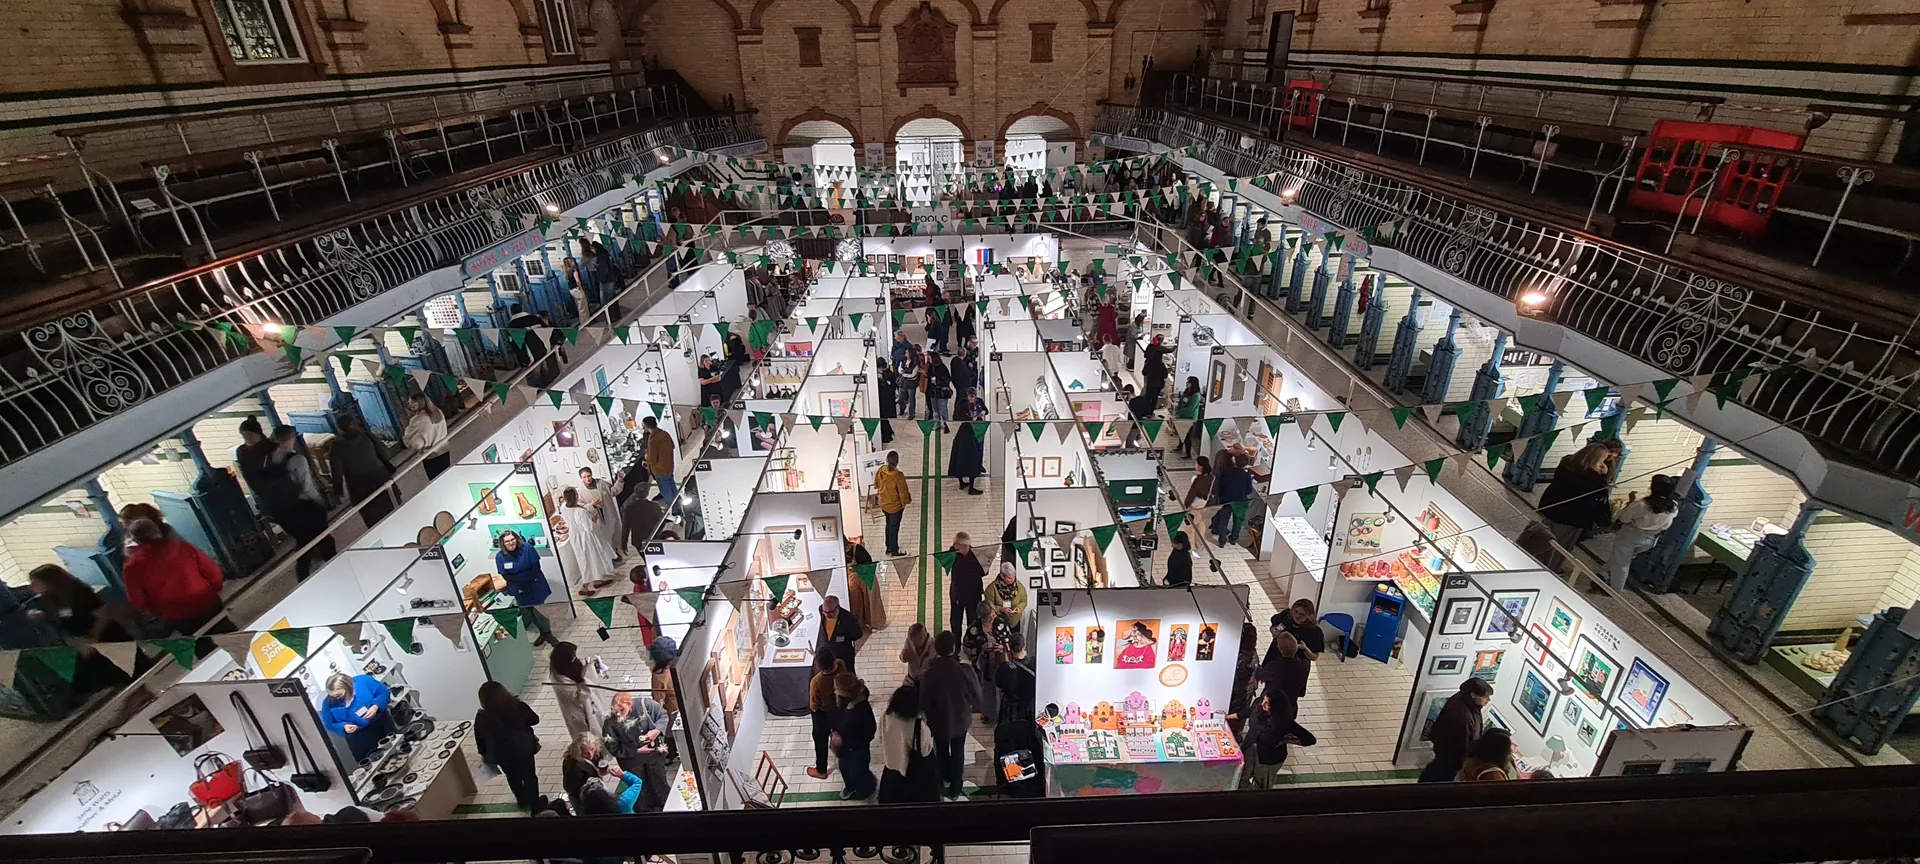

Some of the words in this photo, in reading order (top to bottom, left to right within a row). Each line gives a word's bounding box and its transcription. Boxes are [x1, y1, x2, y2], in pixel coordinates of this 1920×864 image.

[914, 215, 938, 223] POOL
[941, 214, 950, 223] C
[261, 639, 281, 655] Ste
[78, 811, 98, 830] eather
[104, 788, 123, 806] Metal
